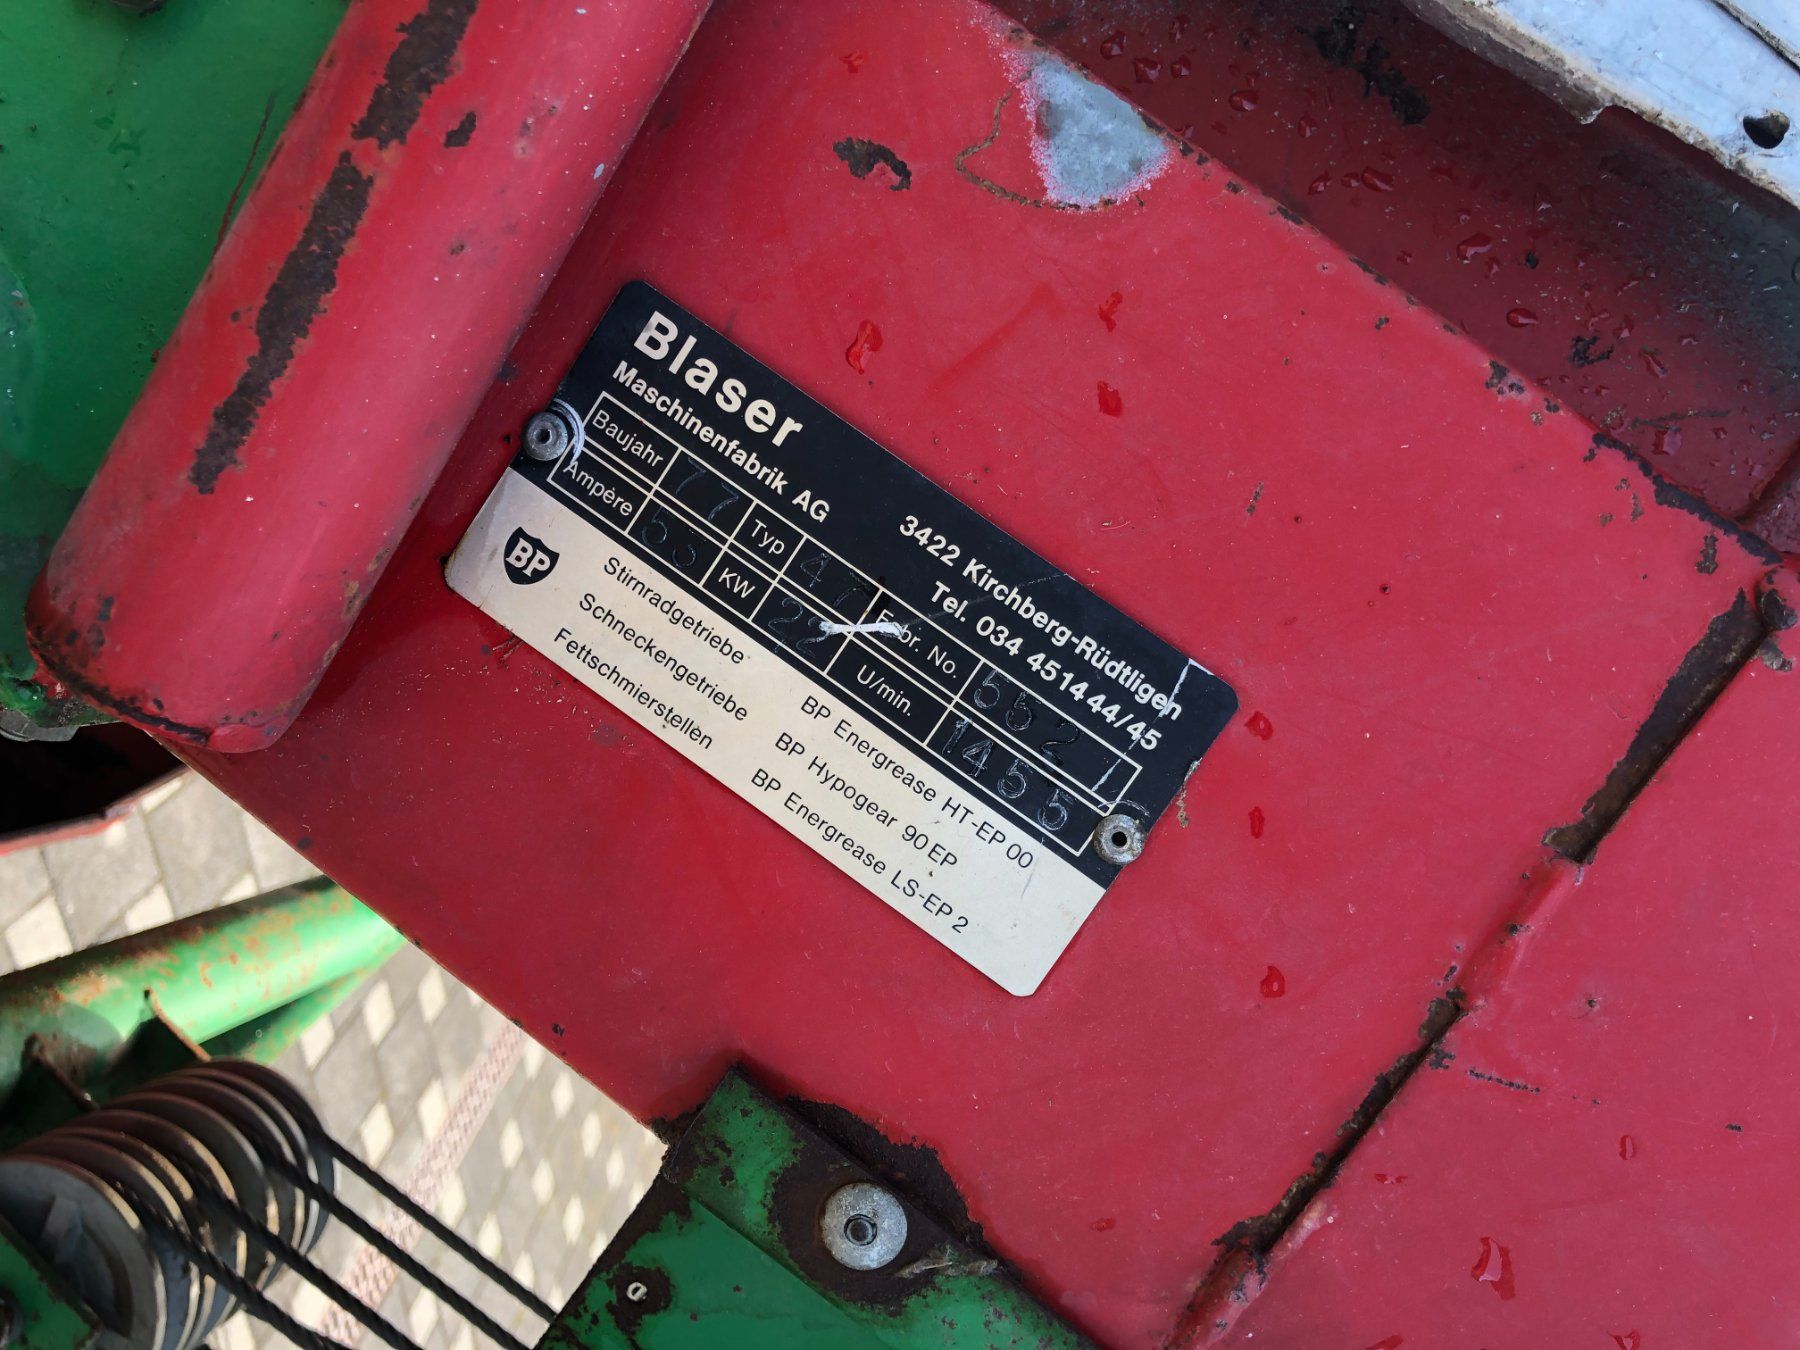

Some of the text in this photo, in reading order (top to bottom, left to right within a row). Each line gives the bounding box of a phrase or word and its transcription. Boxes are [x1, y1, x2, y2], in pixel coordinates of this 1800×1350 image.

[633, 310, 804, 447] Blaser
[561, 461, 634, 516] Ampère
[592, 409, 664, 467] Baujahr
[612, 360, 830, 523] Maschinenfabrik AG
[505, 537, 551, 578] BP
[718, 567, 756, 599] KW
[751, 519, 785, 555] Typ
[579, 592, 748, 721] Schneckengetriebe
[603, 556, 744, 664] Stirnradgetriebe
[874, 608, 920, 655] Fbr.
[926, 645, 957, 679] No.
[899, 515, 1182, 721] 3422 Kirchberg-Rüdtligen
[931, 580, 969, 623] Tel.
[976, 615, 1024, 657] 034
[553, 627, 713, 750] Fettschmierstellen
[856, 664, 911, 717] U/min.
[774, 732, 958, 866] BP Hypogear 90 EP
[800, 695, 831, 720] BP
[833, 718, 937, 802] Energrease
[941, 796, 1006, 845] HT-EP
[751, 768, 969, 934] BP Energrease LS-EP 2
